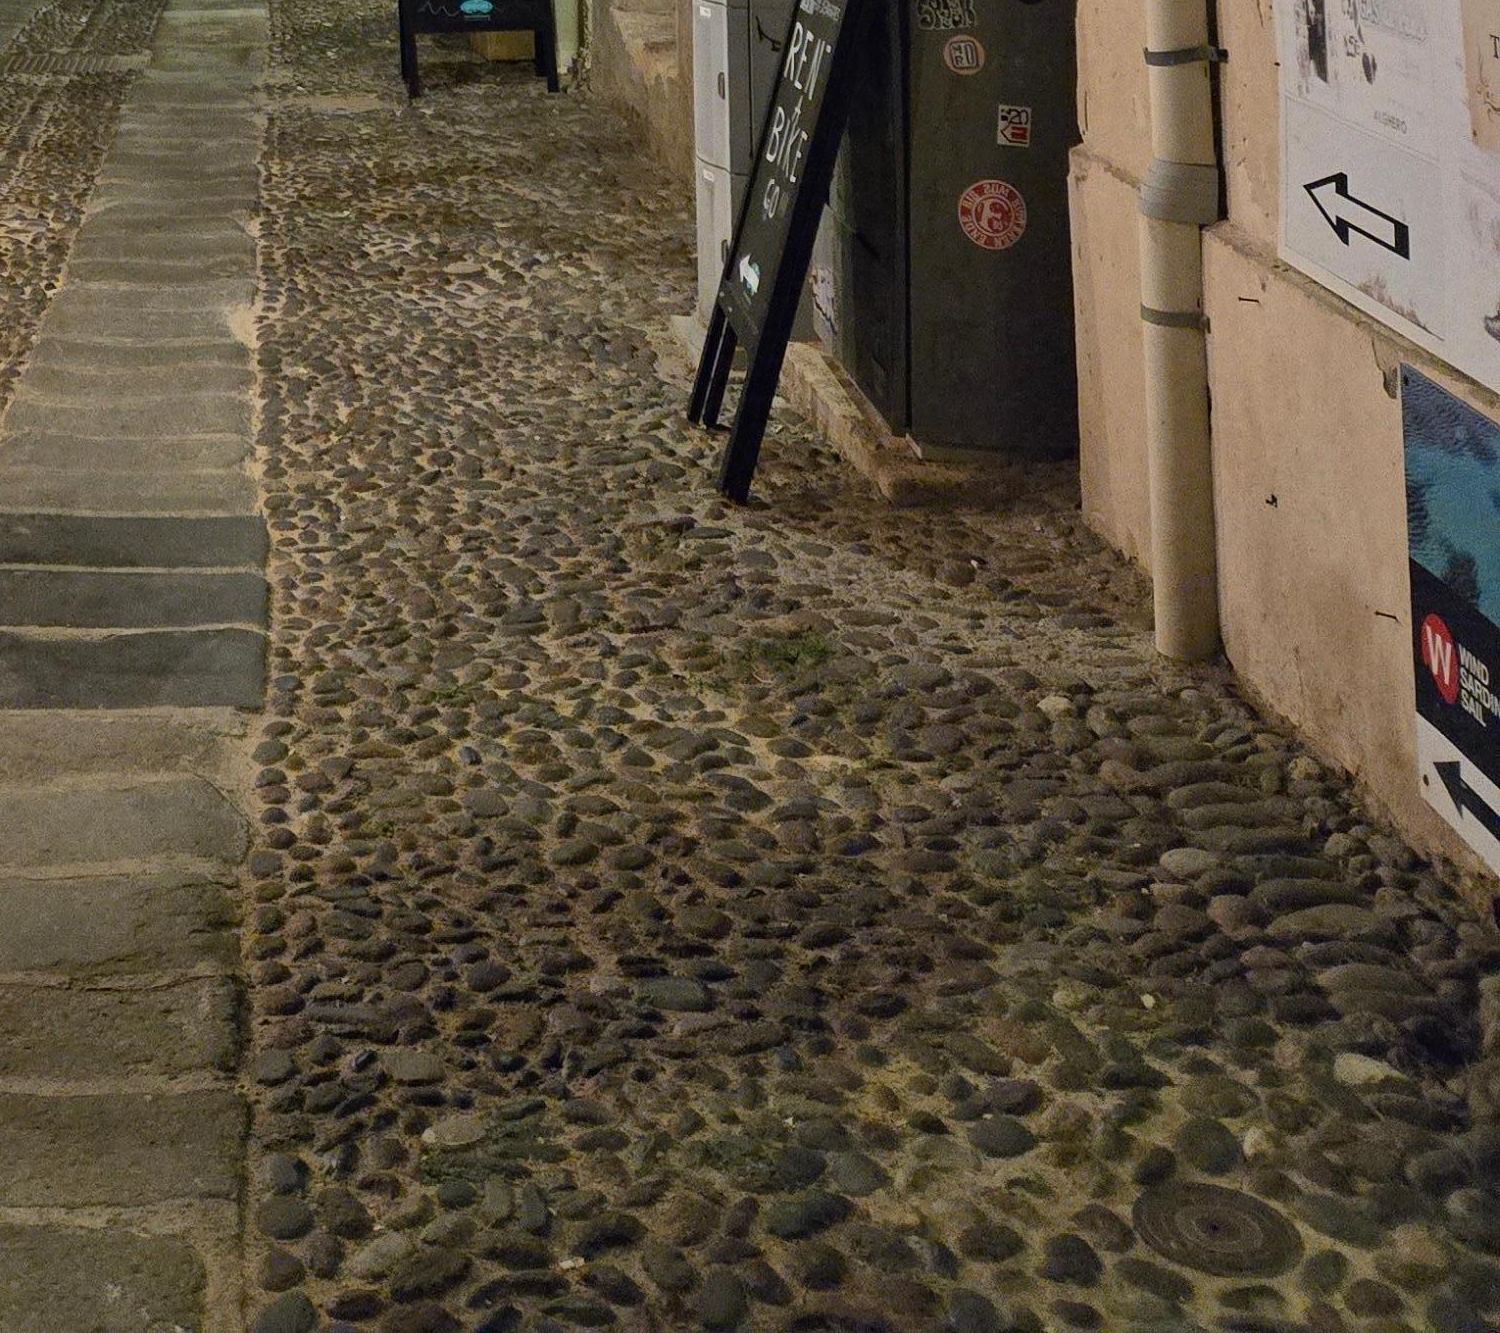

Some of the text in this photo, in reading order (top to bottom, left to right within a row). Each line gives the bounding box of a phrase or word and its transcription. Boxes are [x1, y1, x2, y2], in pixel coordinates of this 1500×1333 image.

[766, 106, 808, 183] BIKE
[1425, 623, 1452, 687] W
[1457, 642, 1489, 686] WIND
[1461, 688, 1486, 728] SAIL
